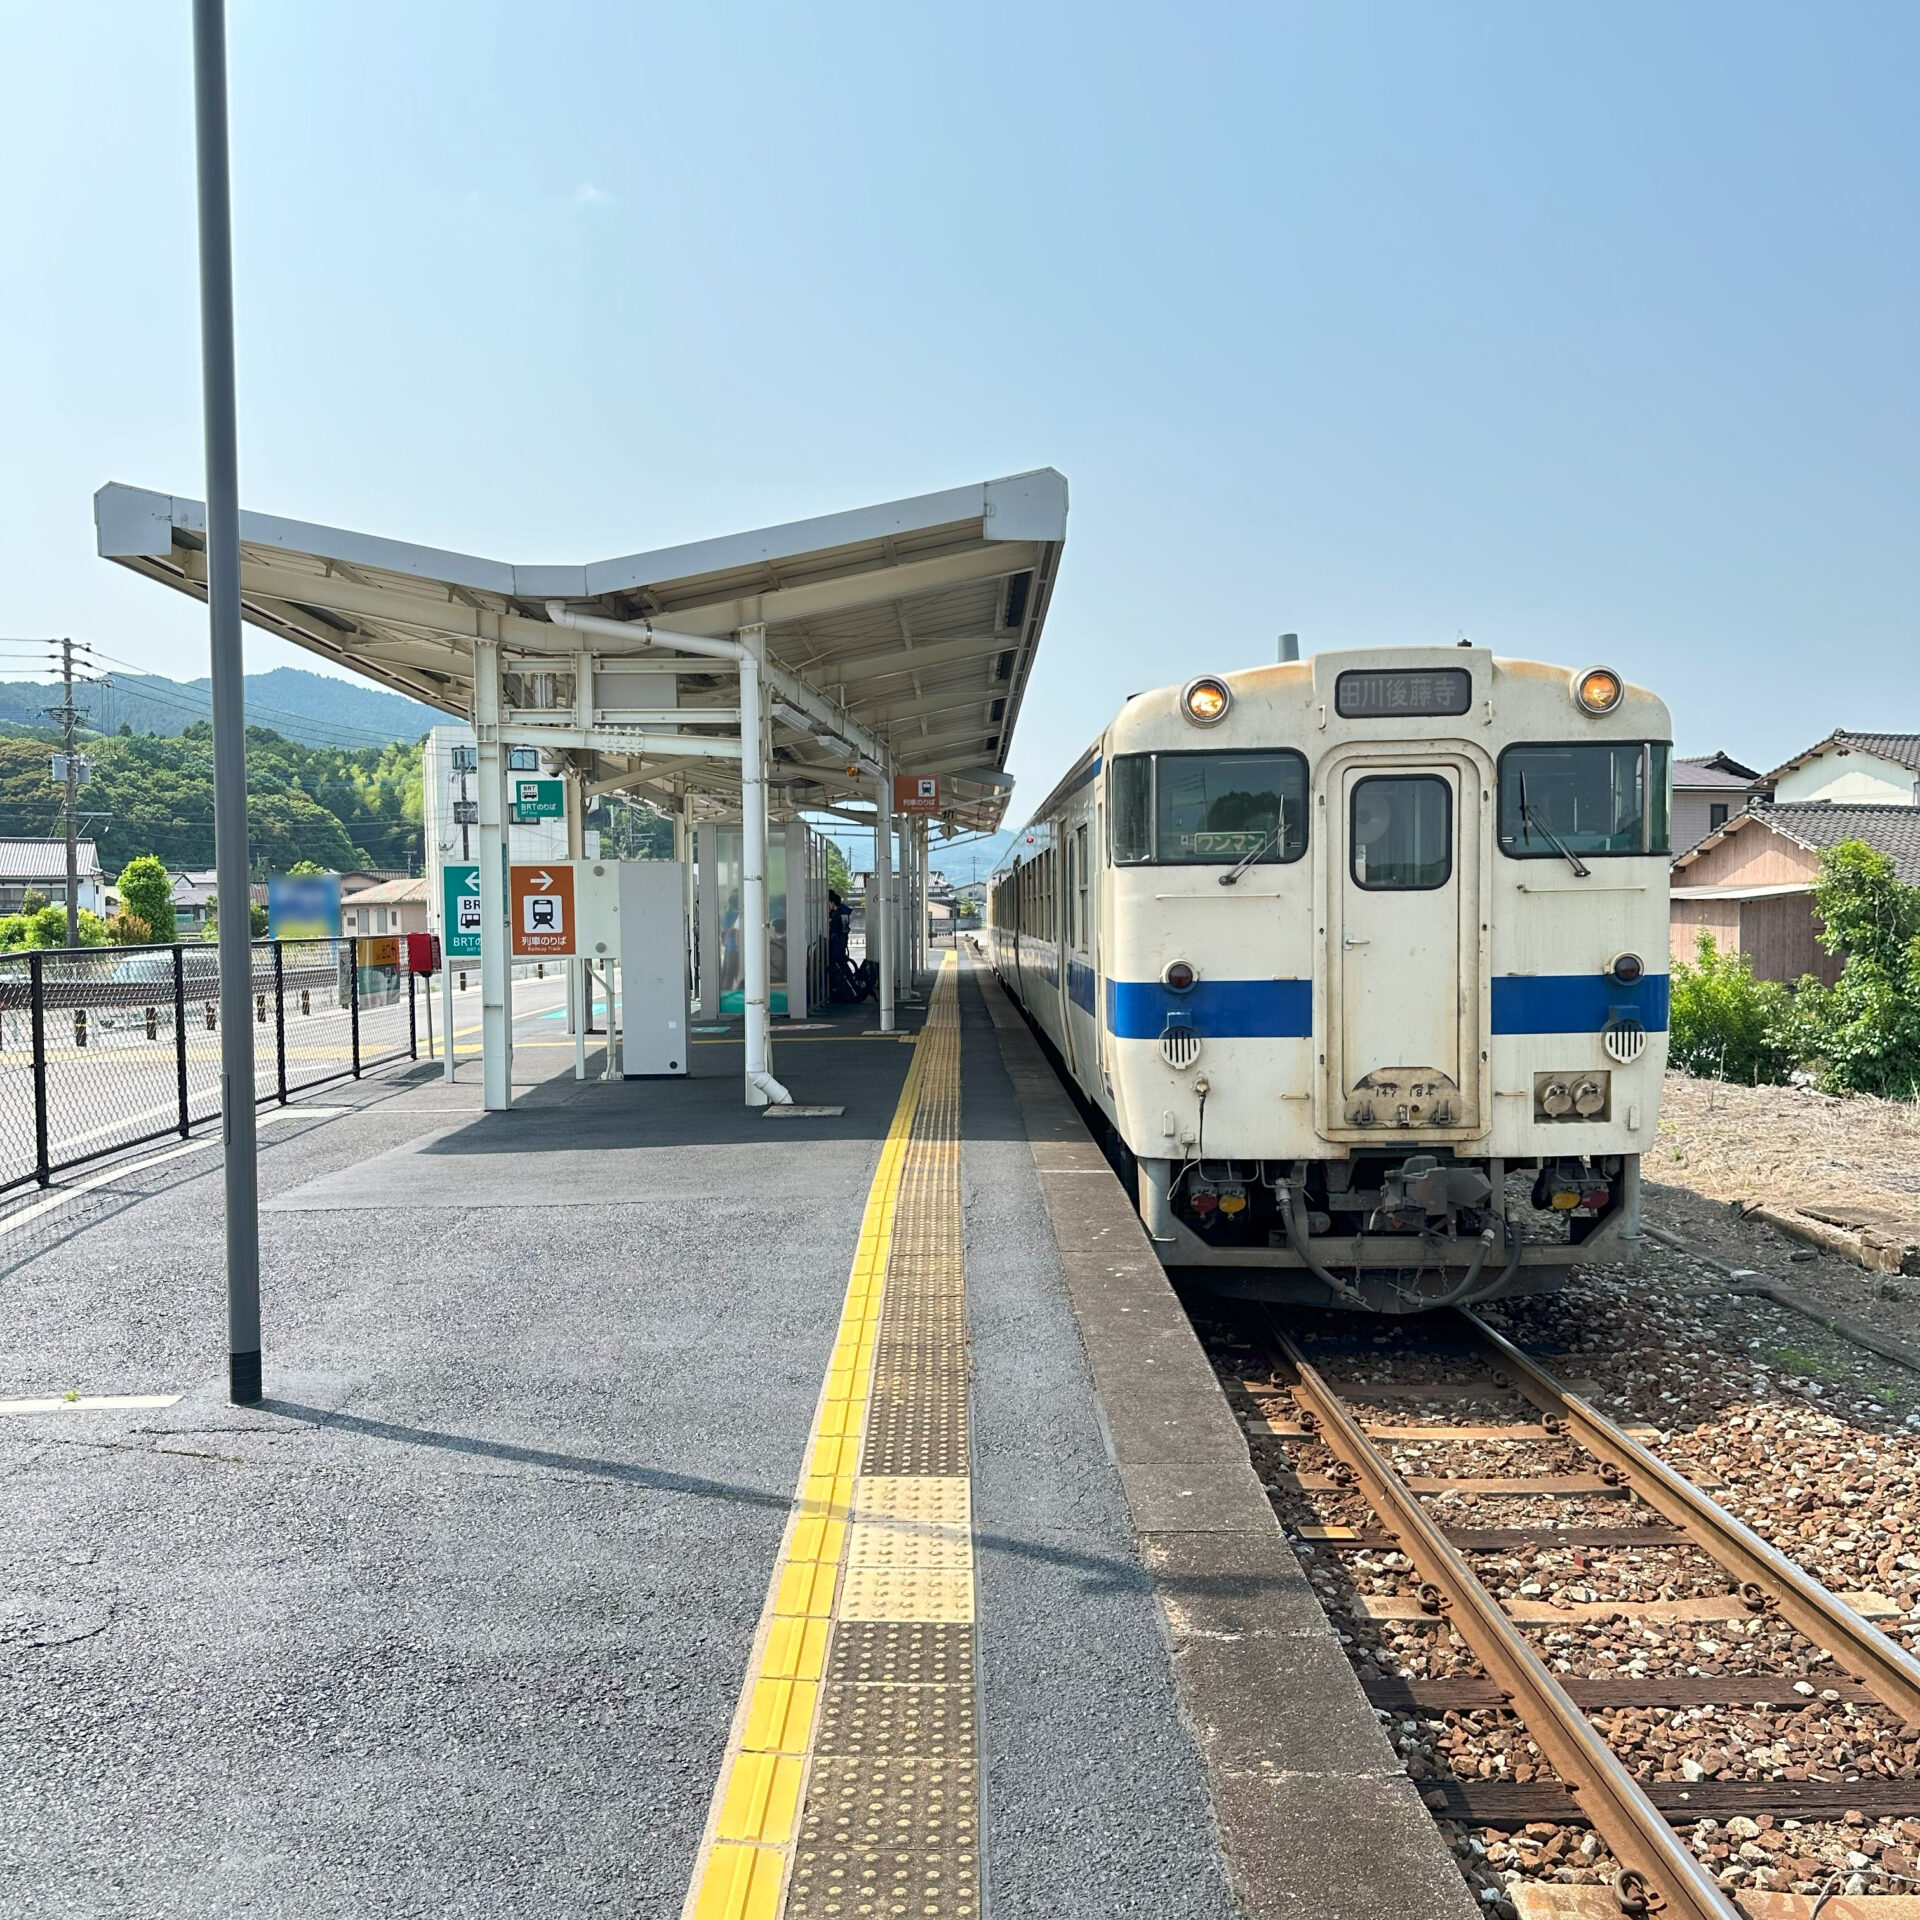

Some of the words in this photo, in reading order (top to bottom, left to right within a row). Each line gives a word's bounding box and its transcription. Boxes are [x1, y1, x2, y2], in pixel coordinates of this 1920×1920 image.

[1339, 677, 1457, 708] 田川後藤寺
[521, 803, 557, 811] BRTのりば
[1198, 834, 1264, 851] ワンマン
[463, 899, 480, 910] BR
[453, 936, 481, 947] BRTの
[521, 936, 567, 946] 列車のりば
[1375, 1088, 1397, 1098] 147
[1409, 1088, 1434, 1098] 184
